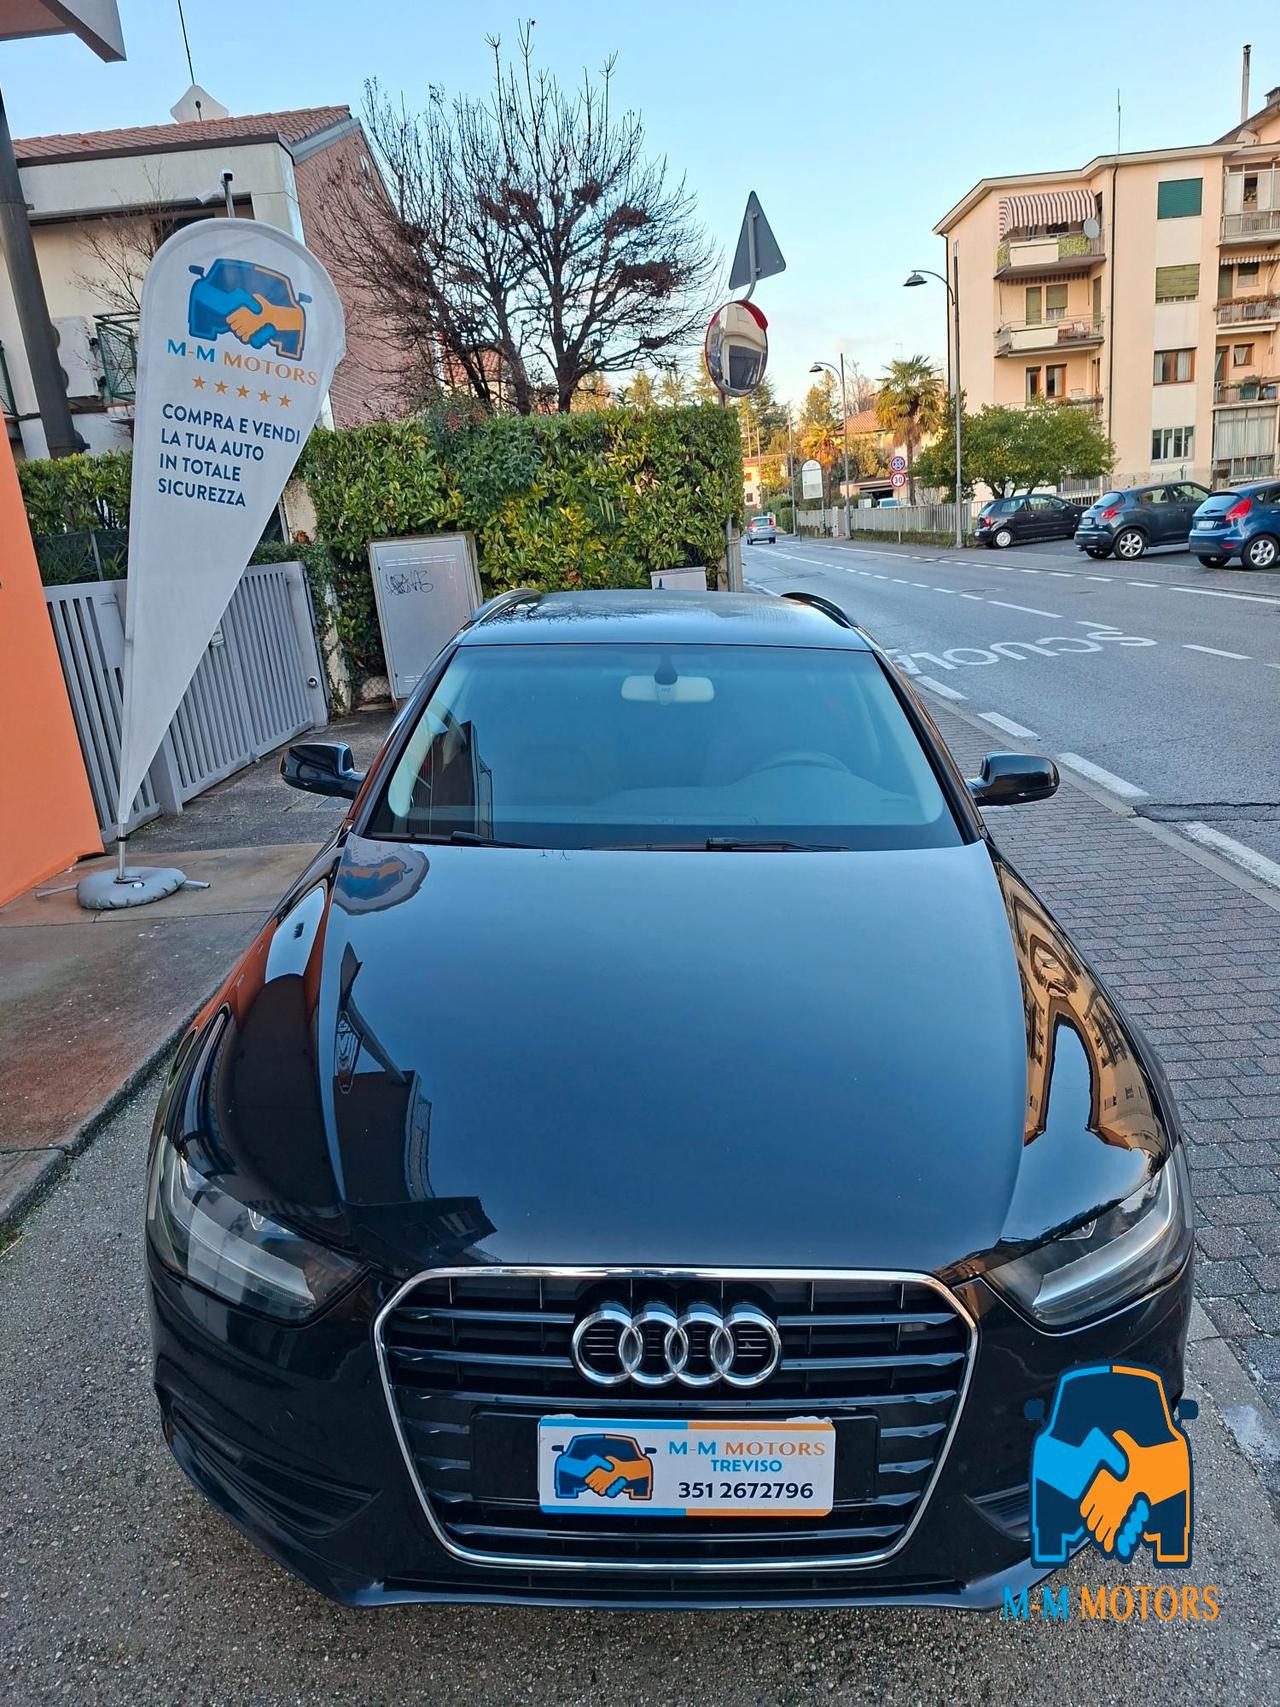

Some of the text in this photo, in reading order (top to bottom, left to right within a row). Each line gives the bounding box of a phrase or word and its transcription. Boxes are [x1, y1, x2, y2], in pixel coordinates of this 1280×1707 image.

[167, 339, 319, 386] M-M MOTORS
[162, 403, 300, 445] COMPRA E VENDI
[161, 428, 264, 461] LA TUA AUTO
[159, 453, 241, 482] IN TOTALE
[158, 478, 246, 507] SICUREZZA
[668, 1440, 826, 1457] M-M MOTORS
[710, 1459, 783, 1473] TREVISO
[678, 1482, 815, 1500] 351 2672796
